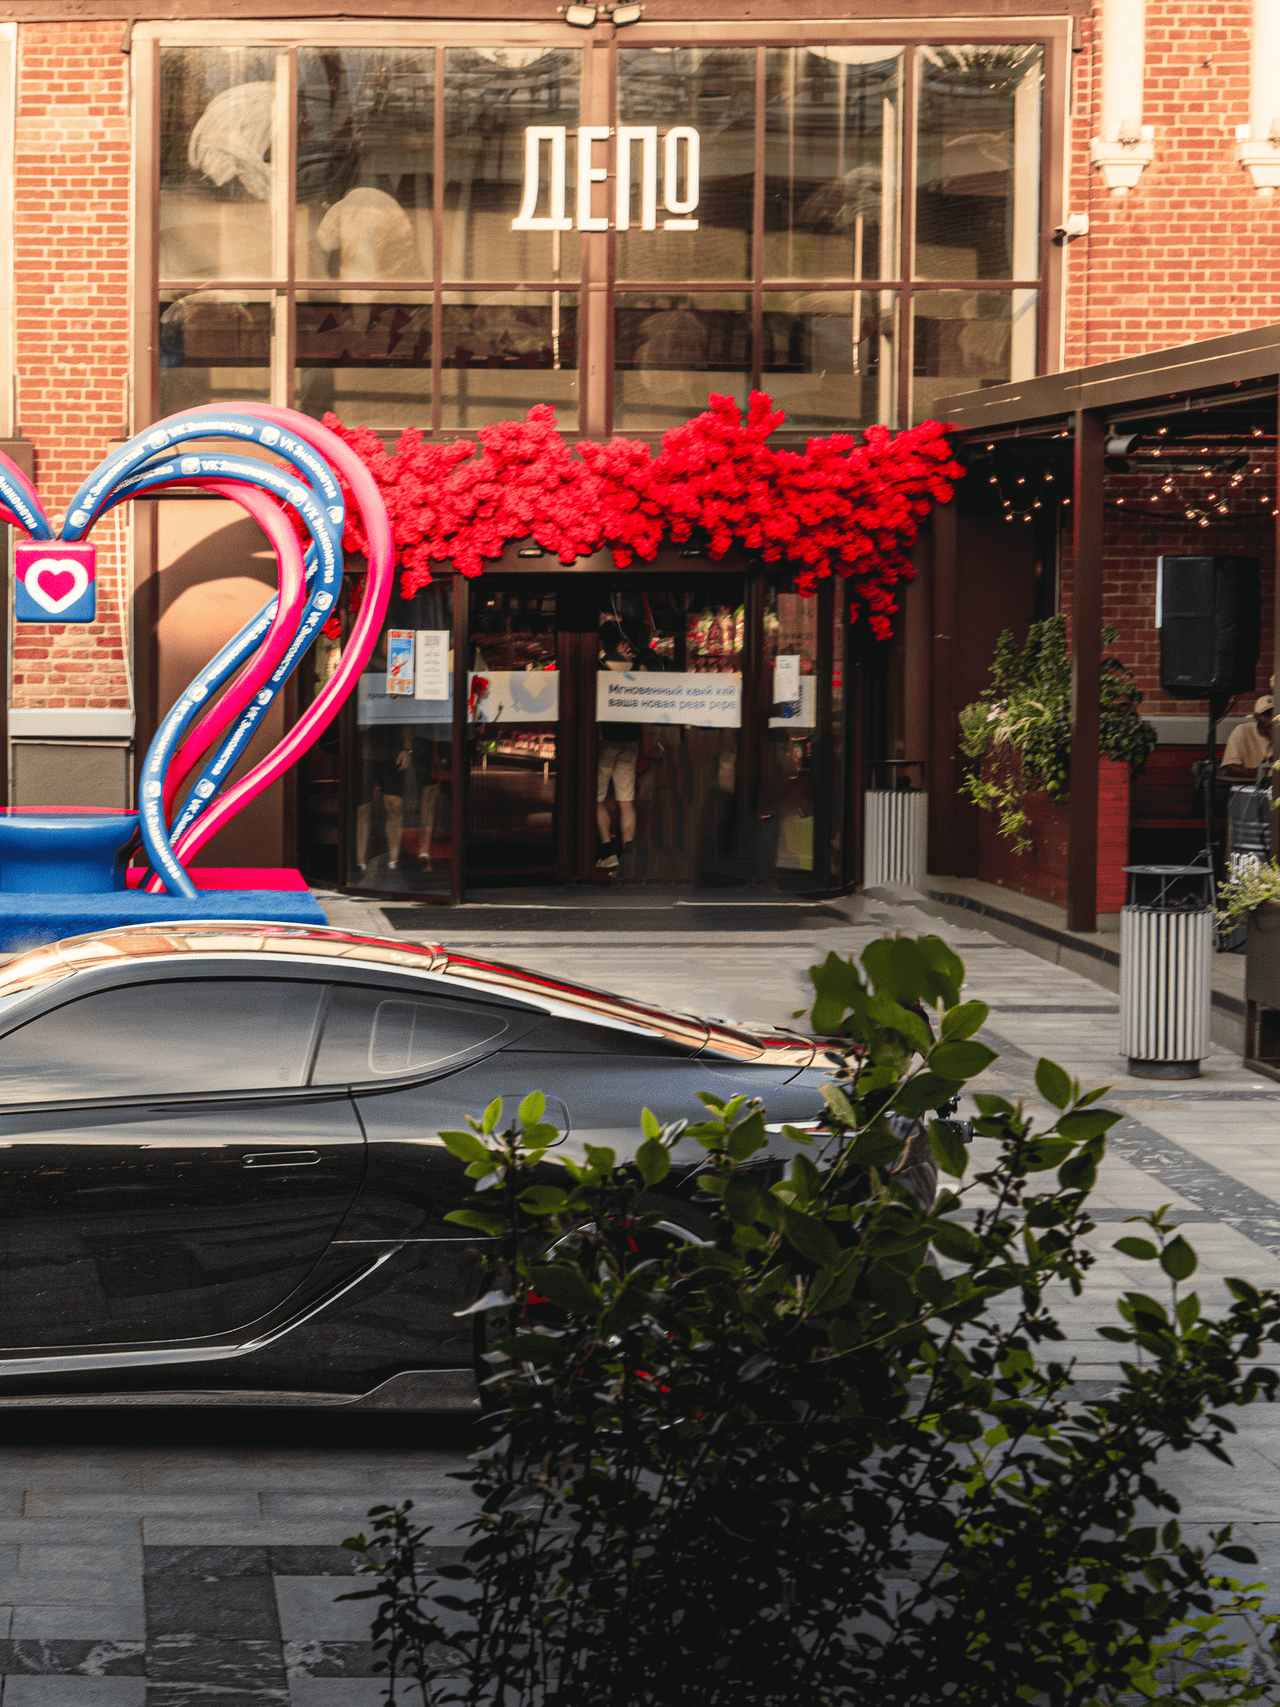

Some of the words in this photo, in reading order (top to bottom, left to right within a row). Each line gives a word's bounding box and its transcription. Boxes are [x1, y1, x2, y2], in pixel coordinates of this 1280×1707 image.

[511, 125, 701, 231] ДЕПО
[280, 436, 297, 452] VK
[303, 502, 320, 521] VK
[145, 800, 158, 817] VK
